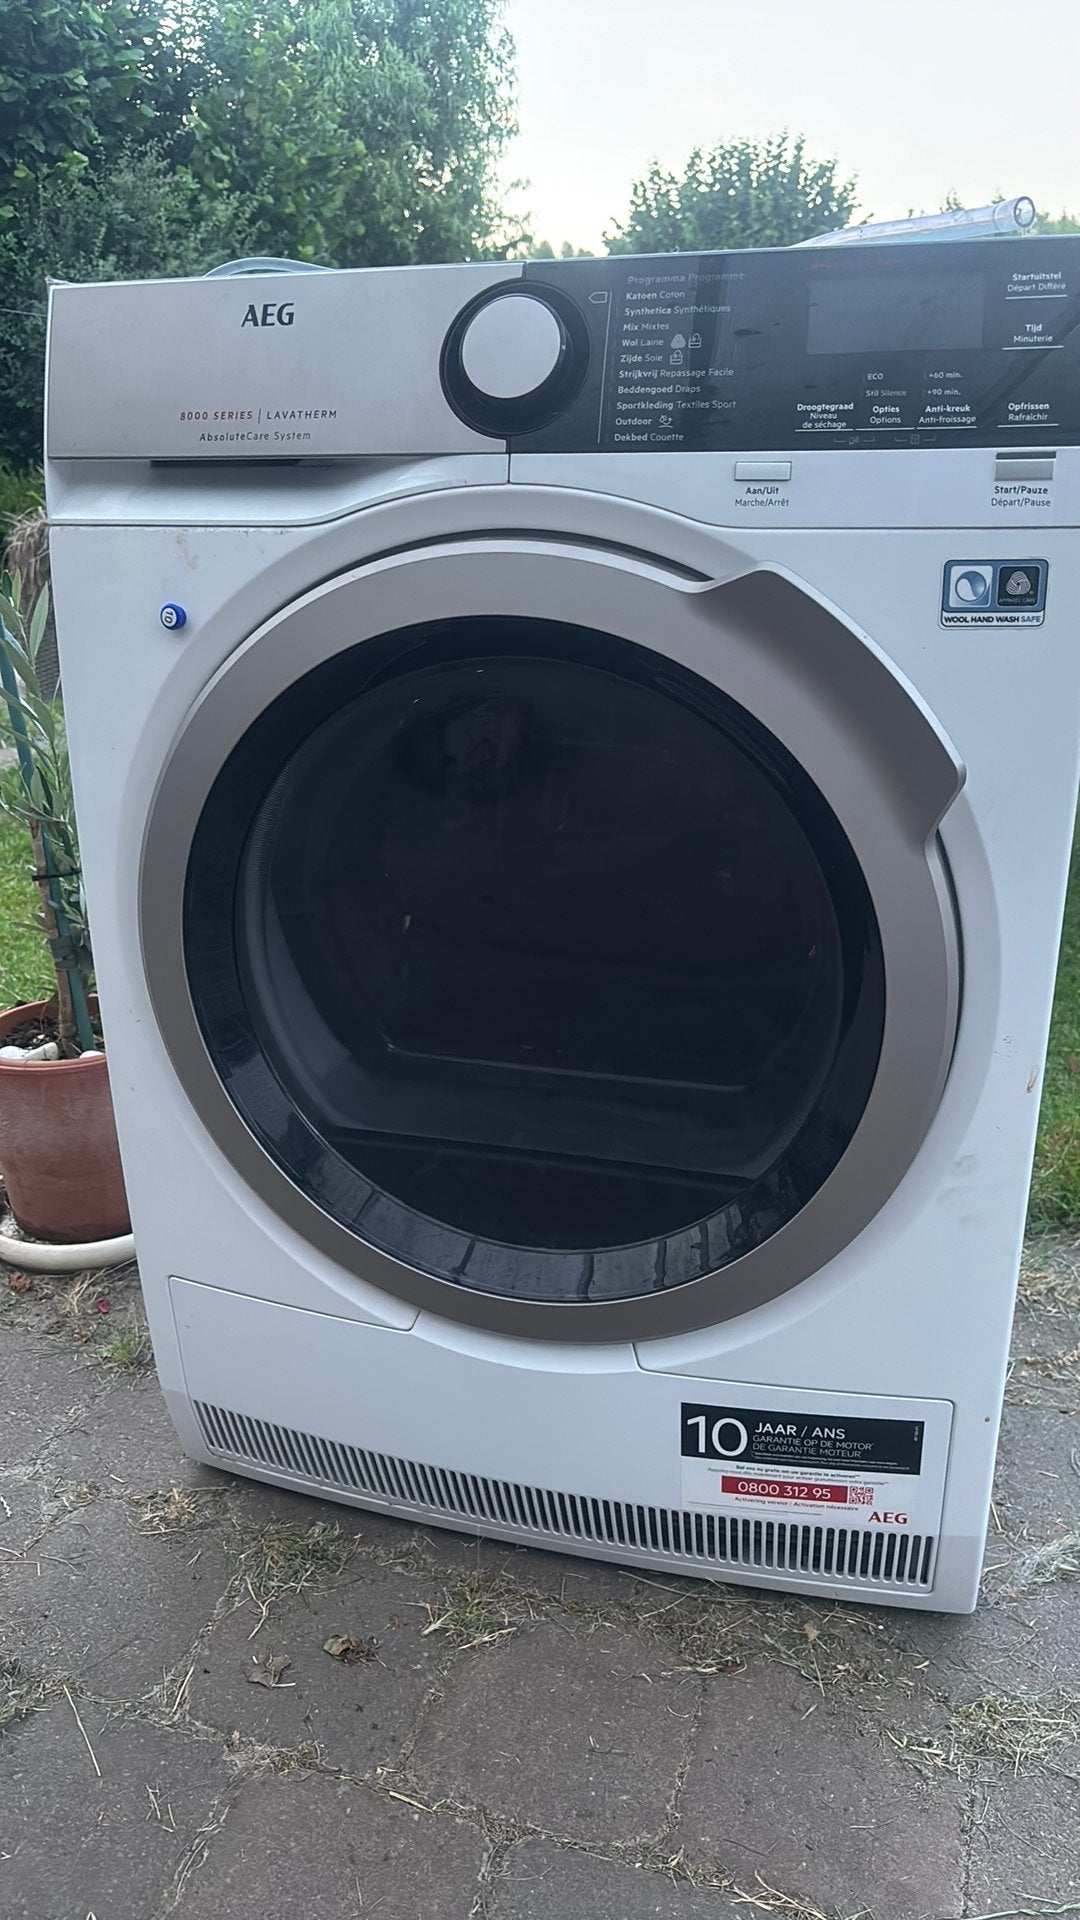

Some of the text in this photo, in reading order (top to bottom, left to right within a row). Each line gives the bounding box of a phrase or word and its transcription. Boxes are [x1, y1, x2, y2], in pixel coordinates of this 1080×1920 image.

[627, 275, 686, 286] Programma
[1012, 271, 1062, 281] Startuitstel
[1007, 283, 1036, 292] Départ
[626, 290, 685, 300] Katoen Coton
[624, 303, 731, 317] Synthetica Synthétiques
[241, 303, 295, 328] AEG
[622, 322, 669, 331] Mix Mixtes
[1025, 323, 1042, 333] Tijd
[622, 338, 664, 347] Wol Laine
[1013, 335, 1053, 343] Minuterie
[620, 353, 663, 364] Zijde Soie
[619, 368, 735, 380] Strijkvrij Repassage Facile
[867, 373, 884, 381] ECO
[946, 371, 963, 379] min.
[617, 384, 701, 395] Beddengoed Draps
[866, 389, 907, 397] Stil Silence
[927, 388, 961, 396] +90 min.
[616, 400, 737, 412] Sportkleding Textiles Sport
[796, 402, 854, 412] Droogtegraad
[872, 405, 900, 414] Opties
[924, 404, 971, 413] Anti-kreuk
[1008, 402, 1050, 412] Opfrissen
[180, 410, 338, 421] 8000 SERIES LAVATHERM
[810, 412, 838, 420] Niveau
[869, 416, 902, 425] Options
[918, 415, 977, 425] Anti-froissage
[615, 417, 653, 426] Outdoor
[802, 420, 847, 430] de séchage
[199, 430, 312, 442] AbsoluteCare System
[614, 432, 684, 442] Dekbed Couette
[745, 486, 780, 495] Aan/Uit
[994, 485, 1049, 494] Start/Pauze
[734, 498, 790, 507] Marche/Arrêt
[990, 497, 1052, 508] Départ/Pause
[686, 1416, 846, 1456] 10 JAAR / ANS
[752, 1434, 801, 1446] GARANTIE
[803, 1438, 818, 1446] OP
[820, 1440, 834, 1448] DE
[752, 1442, 766, 1451] DE
[768, 1444, 816, 1455] GARANTIE
[738, 1481, 832, 1500] 0800 312 95
[734, 1496, 766, 1505] Activering
[868, 1511, 908, 1525] AEG
